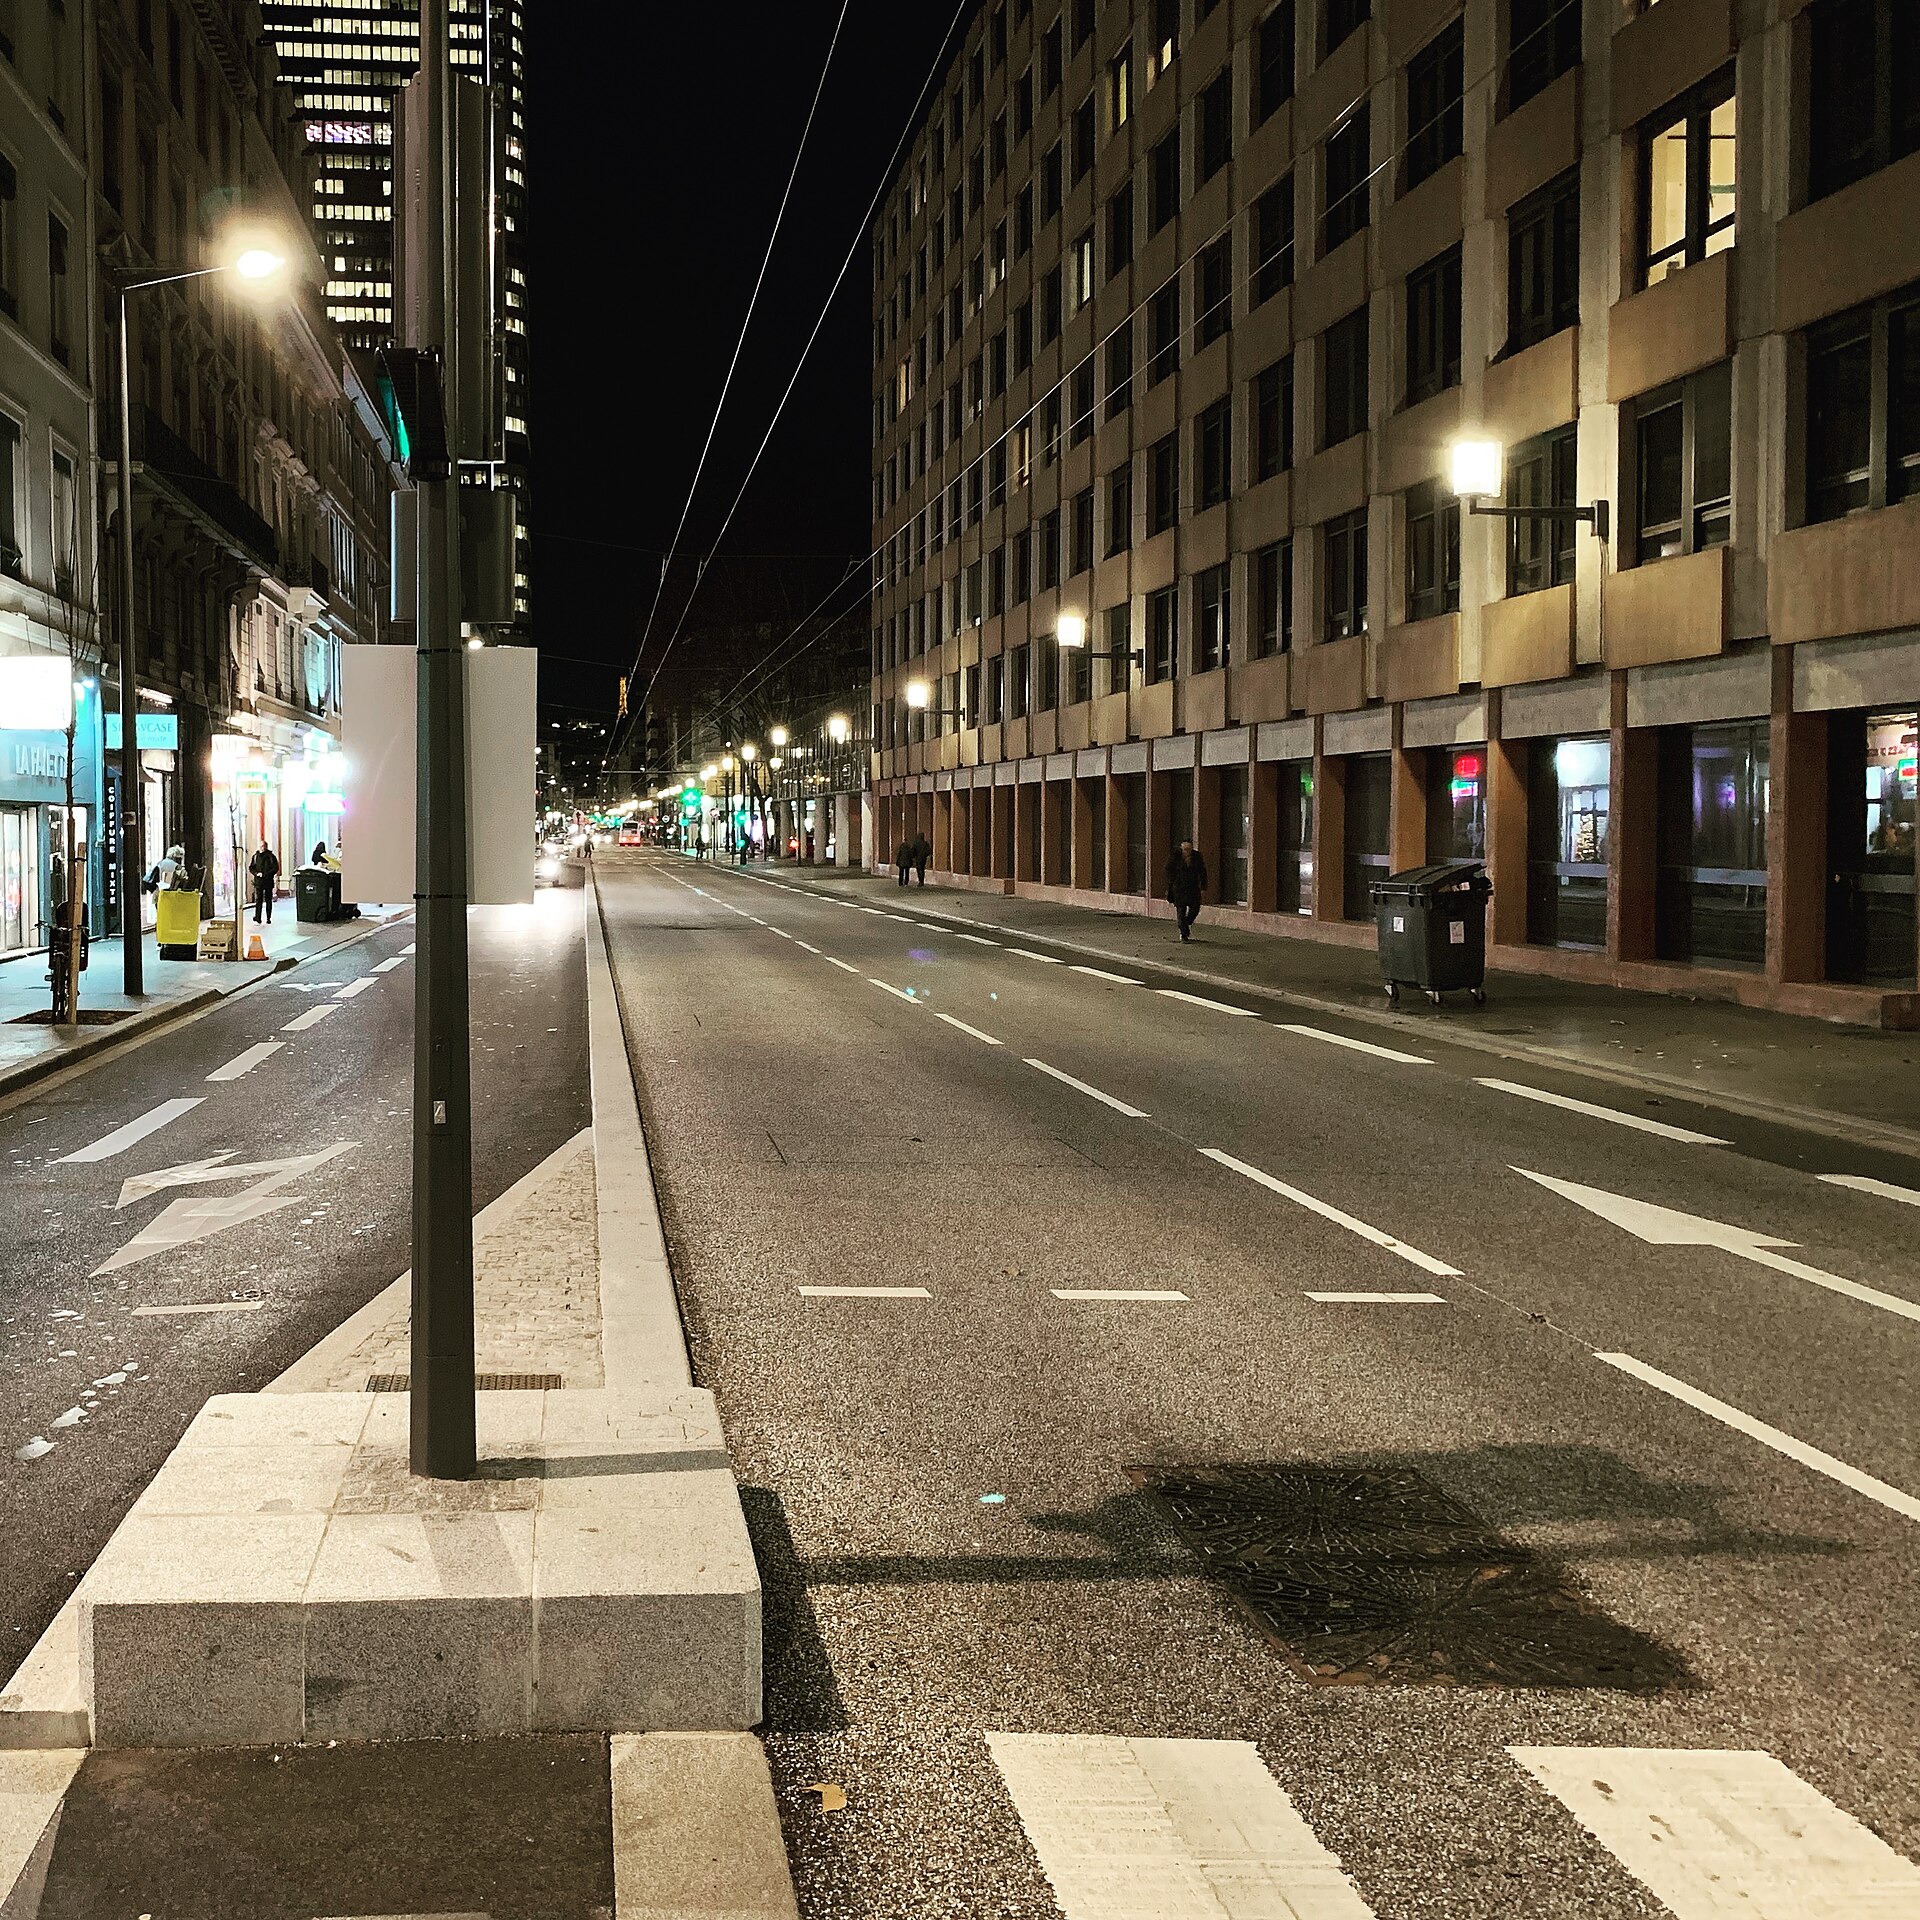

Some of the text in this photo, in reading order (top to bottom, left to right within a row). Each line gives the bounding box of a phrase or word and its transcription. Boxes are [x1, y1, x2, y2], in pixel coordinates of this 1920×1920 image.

[112, 722, 173, 732] SWCASE
[108, 786, 117, 904] COIFFURE MIXTE
